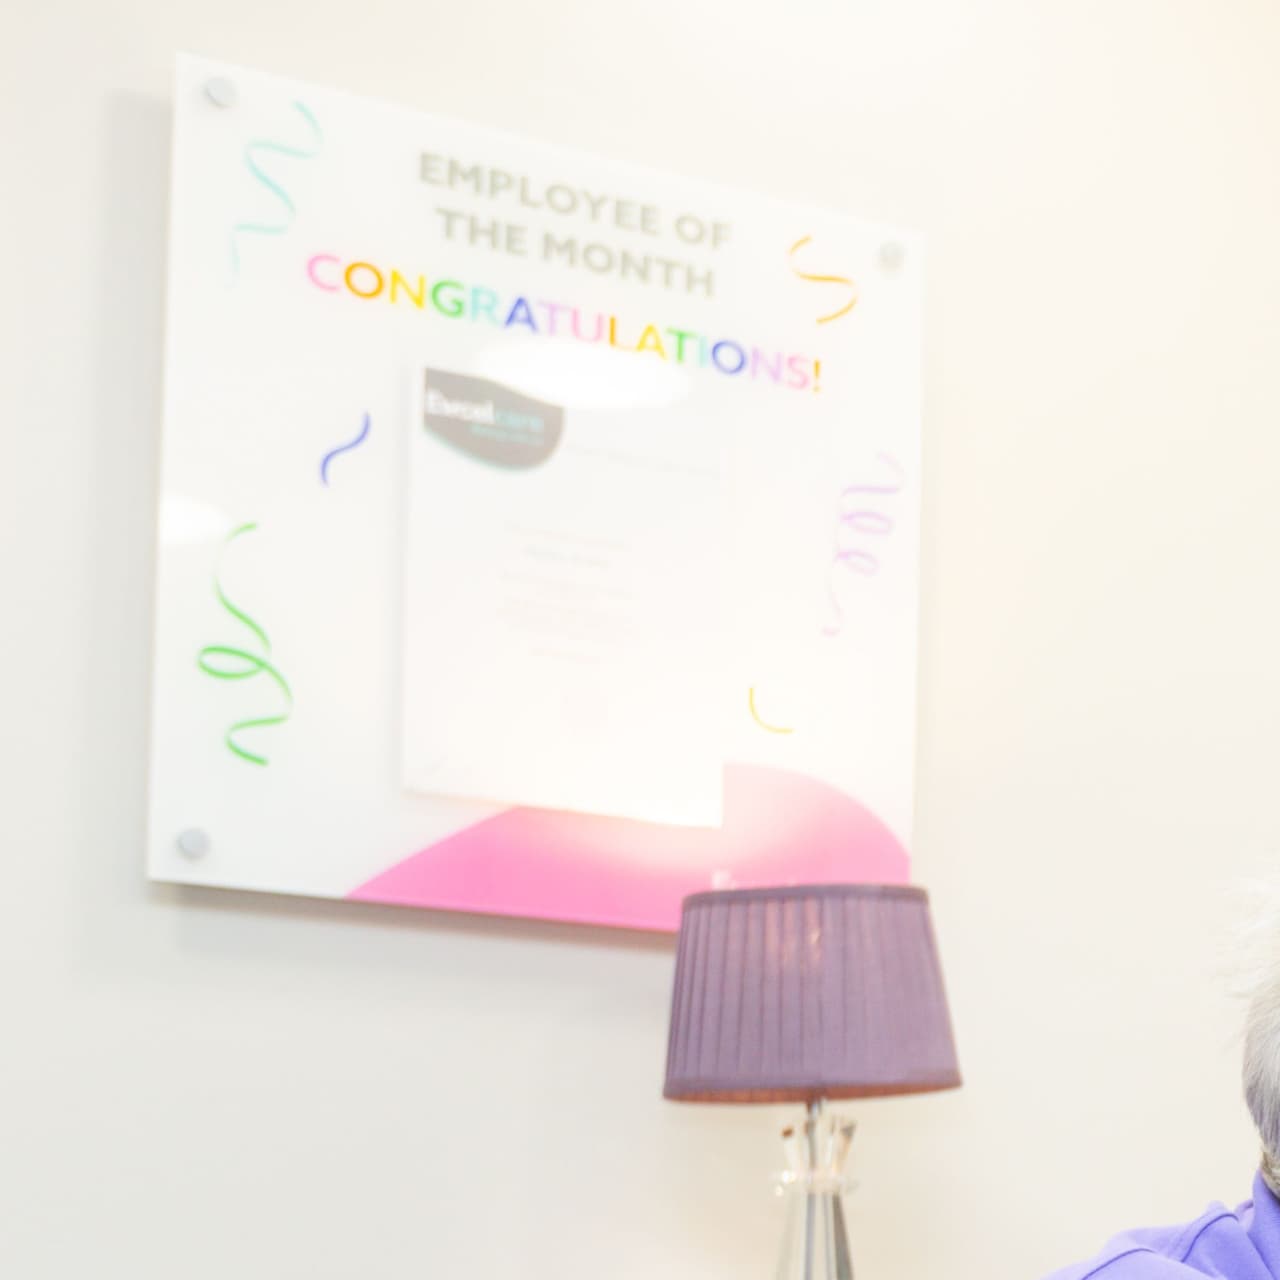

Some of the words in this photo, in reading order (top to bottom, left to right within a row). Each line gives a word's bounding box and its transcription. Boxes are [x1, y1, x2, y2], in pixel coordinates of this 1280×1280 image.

[418, 150, 664, 240] EMPLOYEE
[672, 209, 734, 250] OF
[434, 207, 529, 259] THE
[541, 230, 718, 298] MONTH
[305, 252, 824, 394] CONGRATULATIONS!
